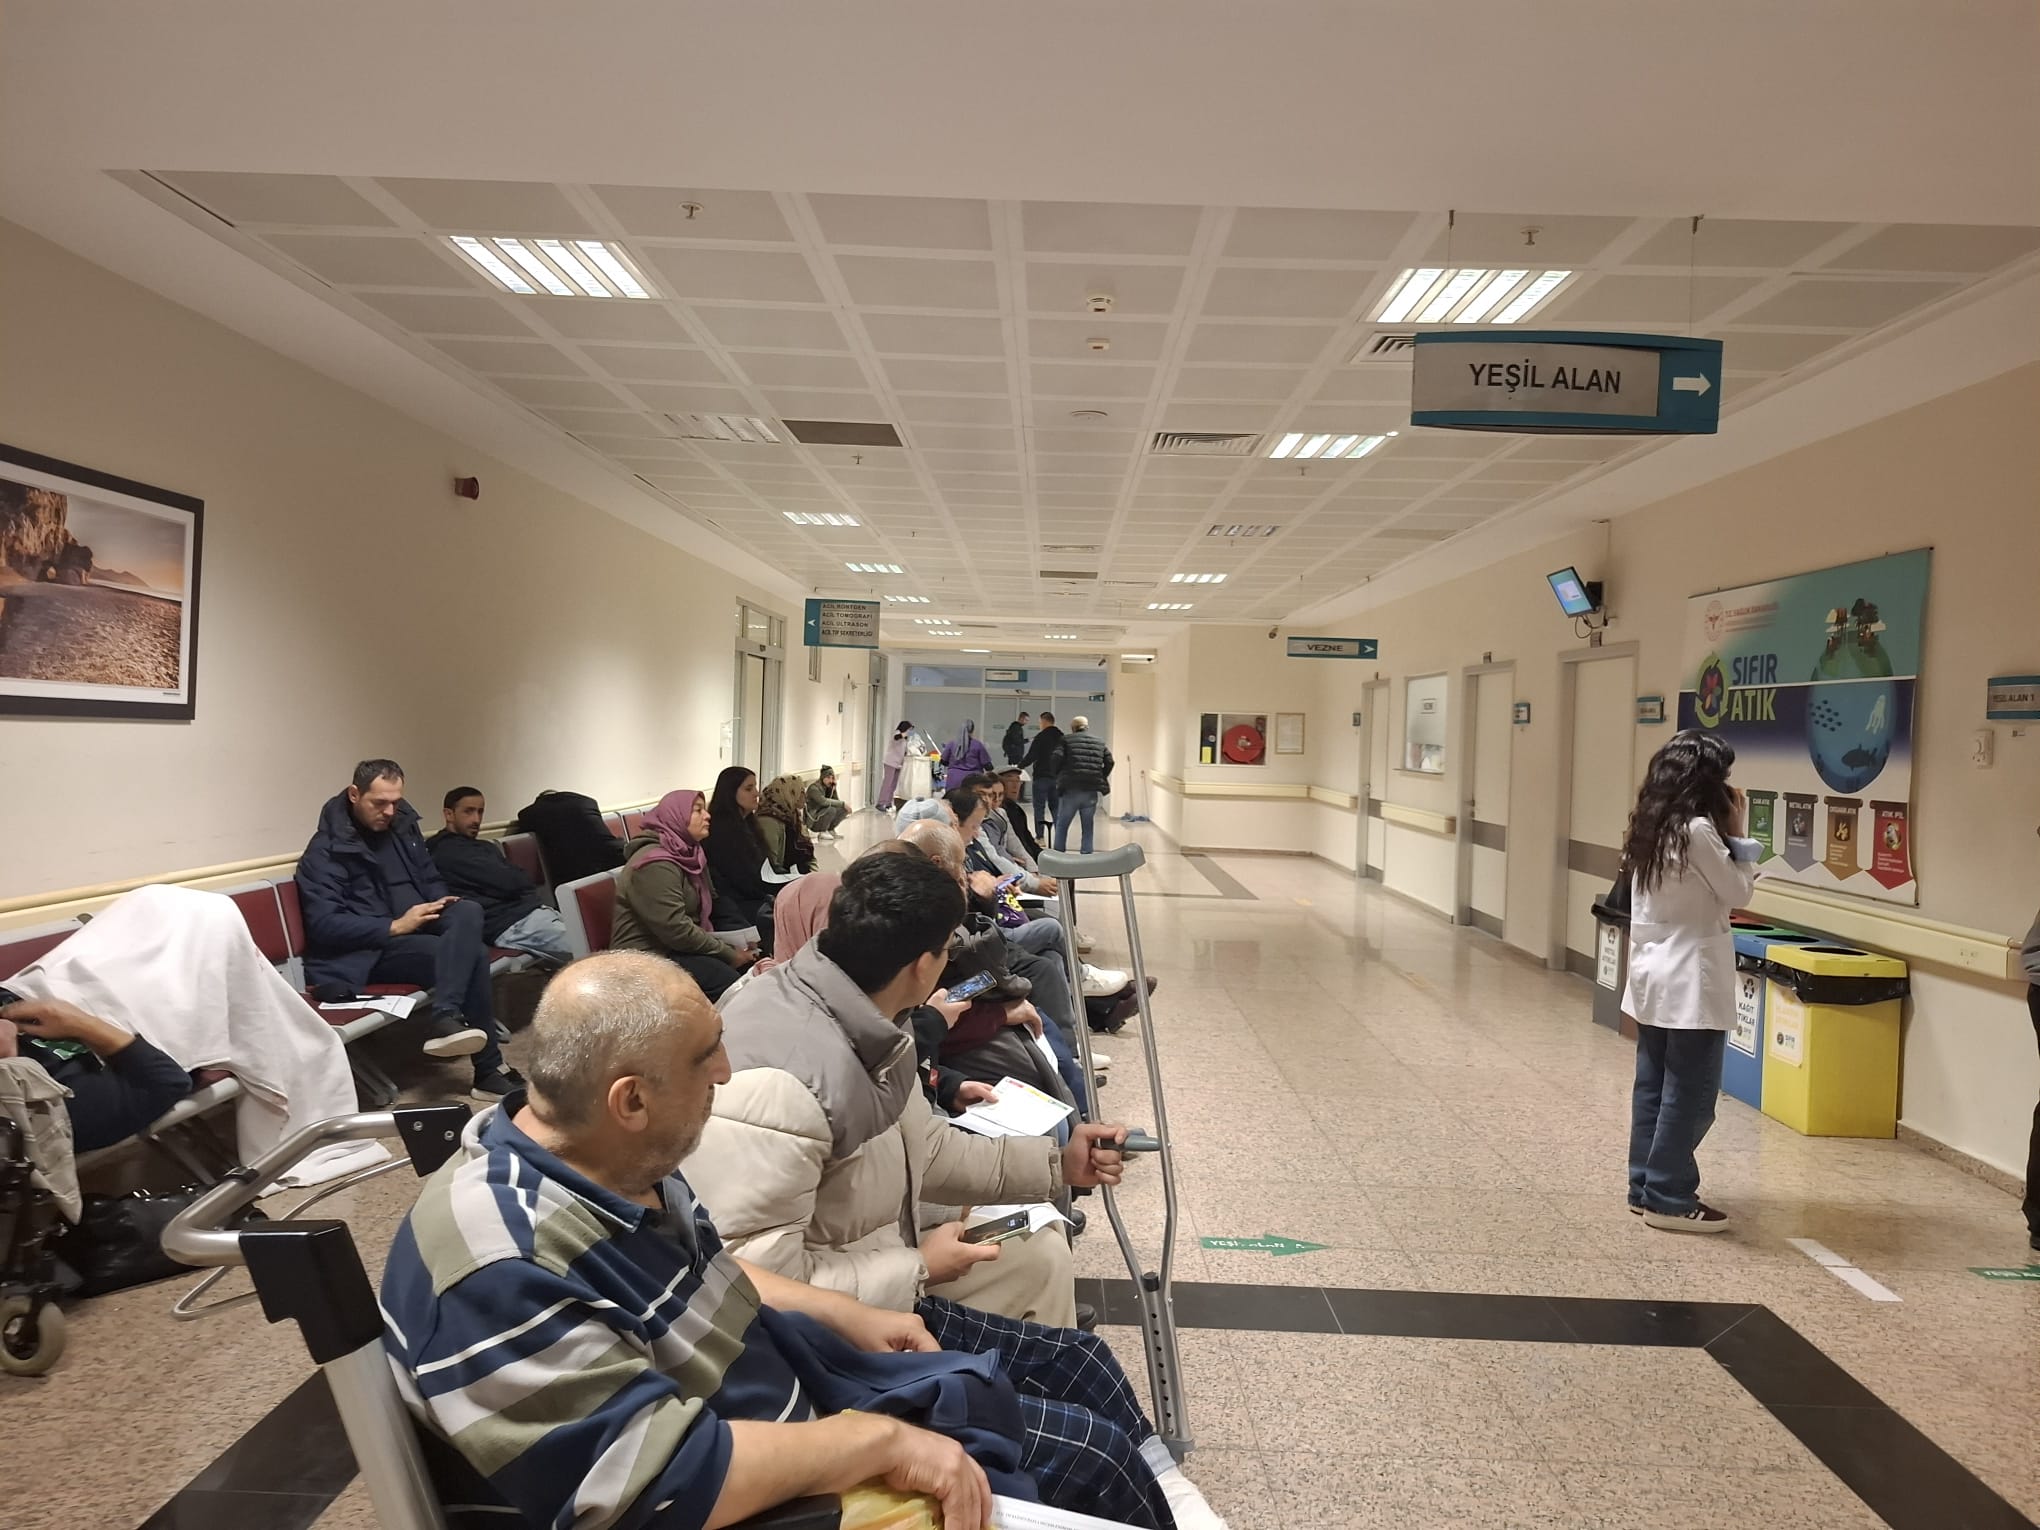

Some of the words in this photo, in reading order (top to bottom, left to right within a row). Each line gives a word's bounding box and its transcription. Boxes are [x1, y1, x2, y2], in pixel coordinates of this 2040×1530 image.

[1469, 359, 1544, 392] YEŞİL
[1551, 366, 1621, 394] ALAN
[1307, 644, 1344, 652] VEZNE
[1732, 653, 1778, 686] SIFIR
[1730, 688, 1777, 721] ATIK
